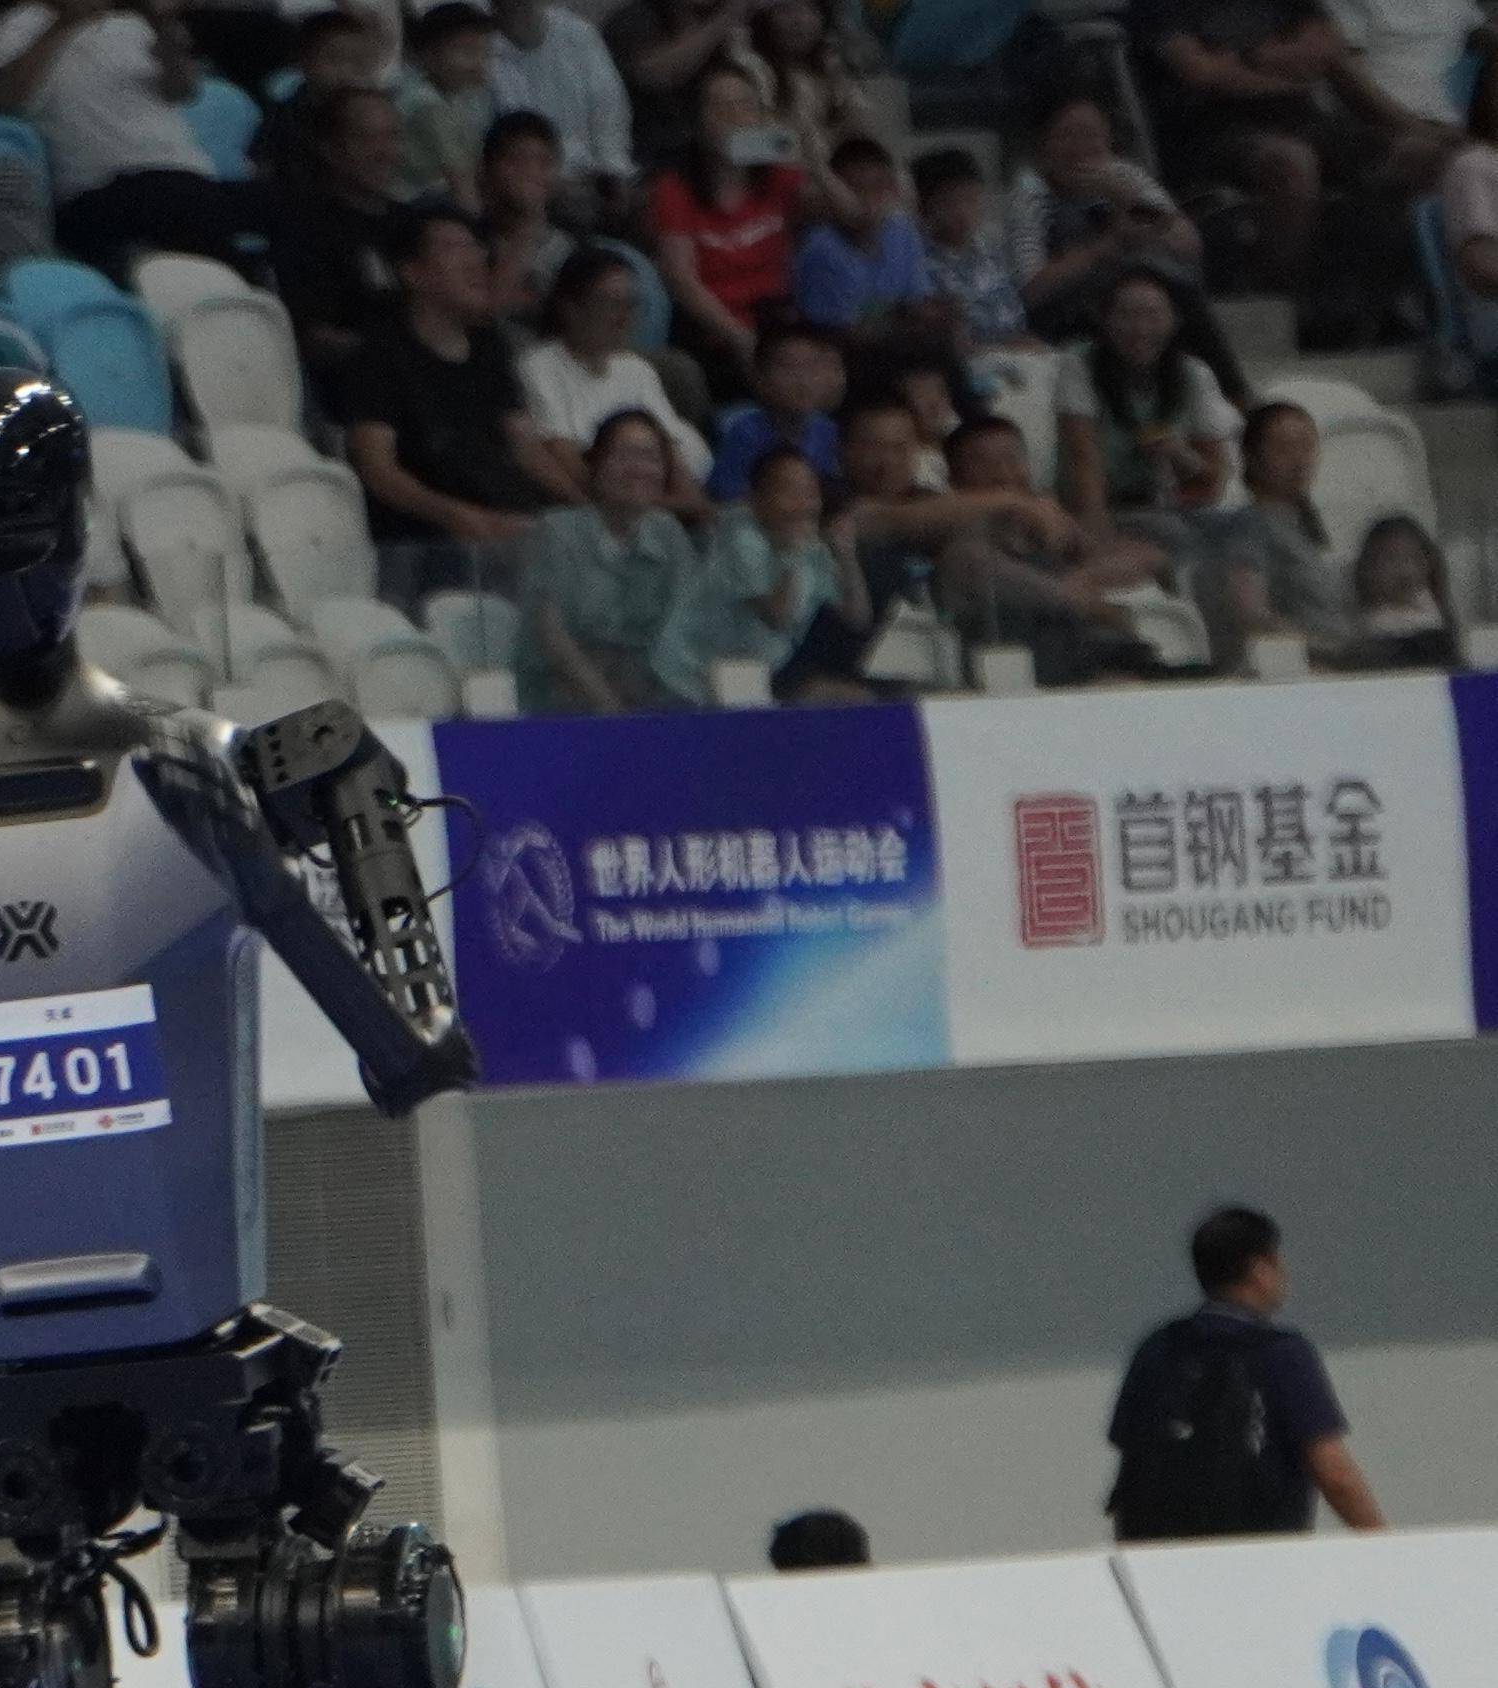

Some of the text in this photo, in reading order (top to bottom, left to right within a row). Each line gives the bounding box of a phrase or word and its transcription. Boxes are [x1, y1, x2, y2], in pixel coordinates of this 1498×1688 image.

[589, 826, 908, 897] 世界人形机器人运动会
[1116, 776, 1386, 893] 首钢基金
[1120, 894, 1394, 944] SHOUGANG FUND
